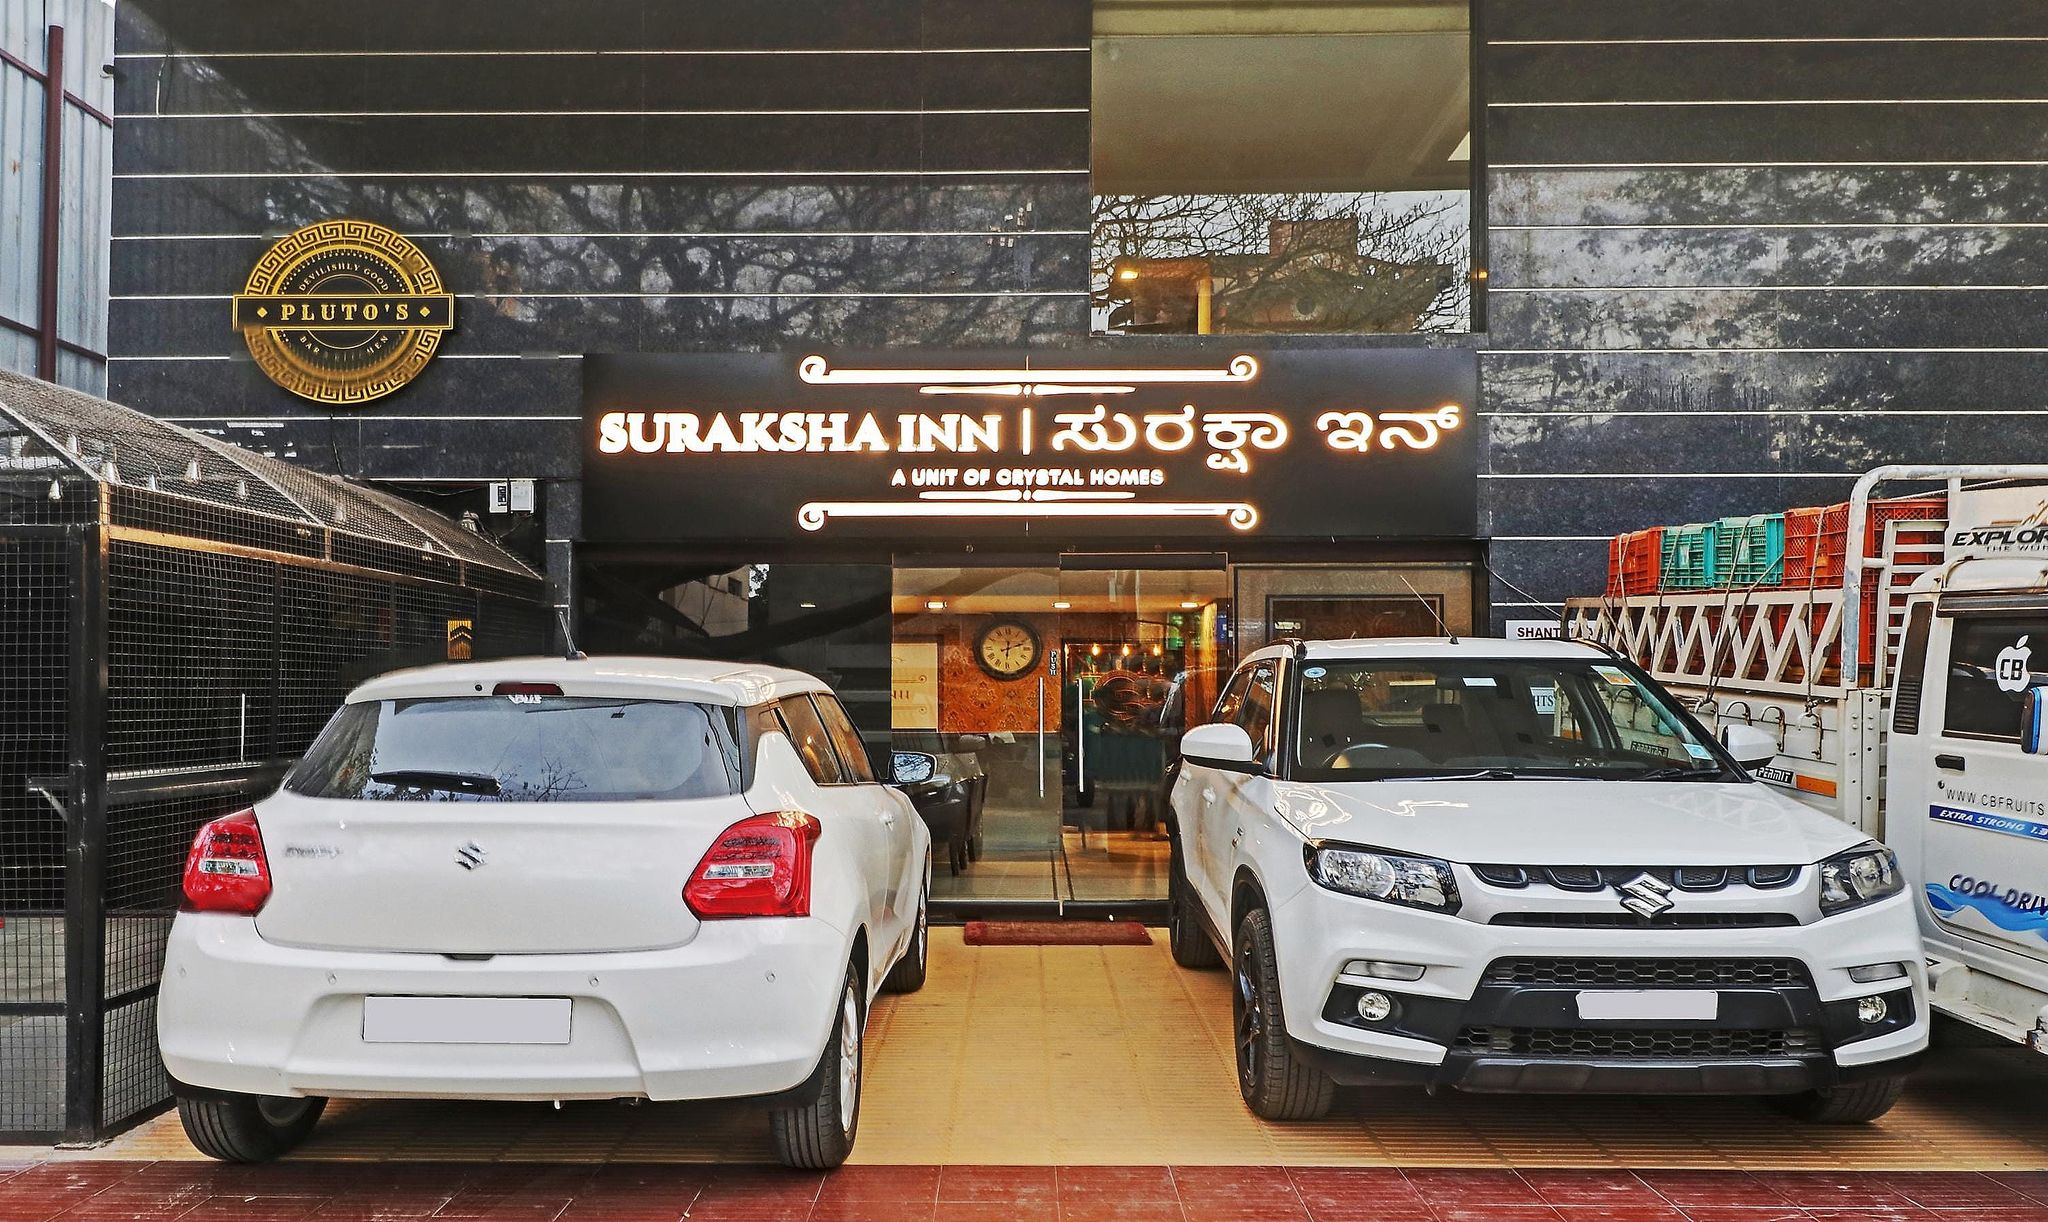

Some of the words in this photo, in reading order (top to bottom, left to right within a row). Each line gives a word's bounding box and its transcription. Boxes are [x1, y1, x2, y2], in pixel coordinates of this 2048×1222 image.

[299, 262, 360, 291] DEVILISHLY
[363, 268, 389, 291] GOOD
[280, 303, 409, 321] PLUTO'S
[599, 412, 890, 454] SURAKSHA
[897, 414, 1002, 453] INN
[1051, 404, 1289, 474] ಸುರಕ್ಷಾ
[1316, 405, 1460, 453] ಇನ್
[891, 468, 906, 486] A
[911, 468, 959, 486] UNIT
[963, 468, 991, 486] OF
[995, 468, 1085, 486] CRYSTAL
[1090, 468, 1165, 486] HOMES
[2000, 659, 2024, 680] CB
[1758, 767, 1791, 782] PERMIT
[1940, 809, 1974, 822] EXTRA
[1976, 816, 2025, 831] STRONG
